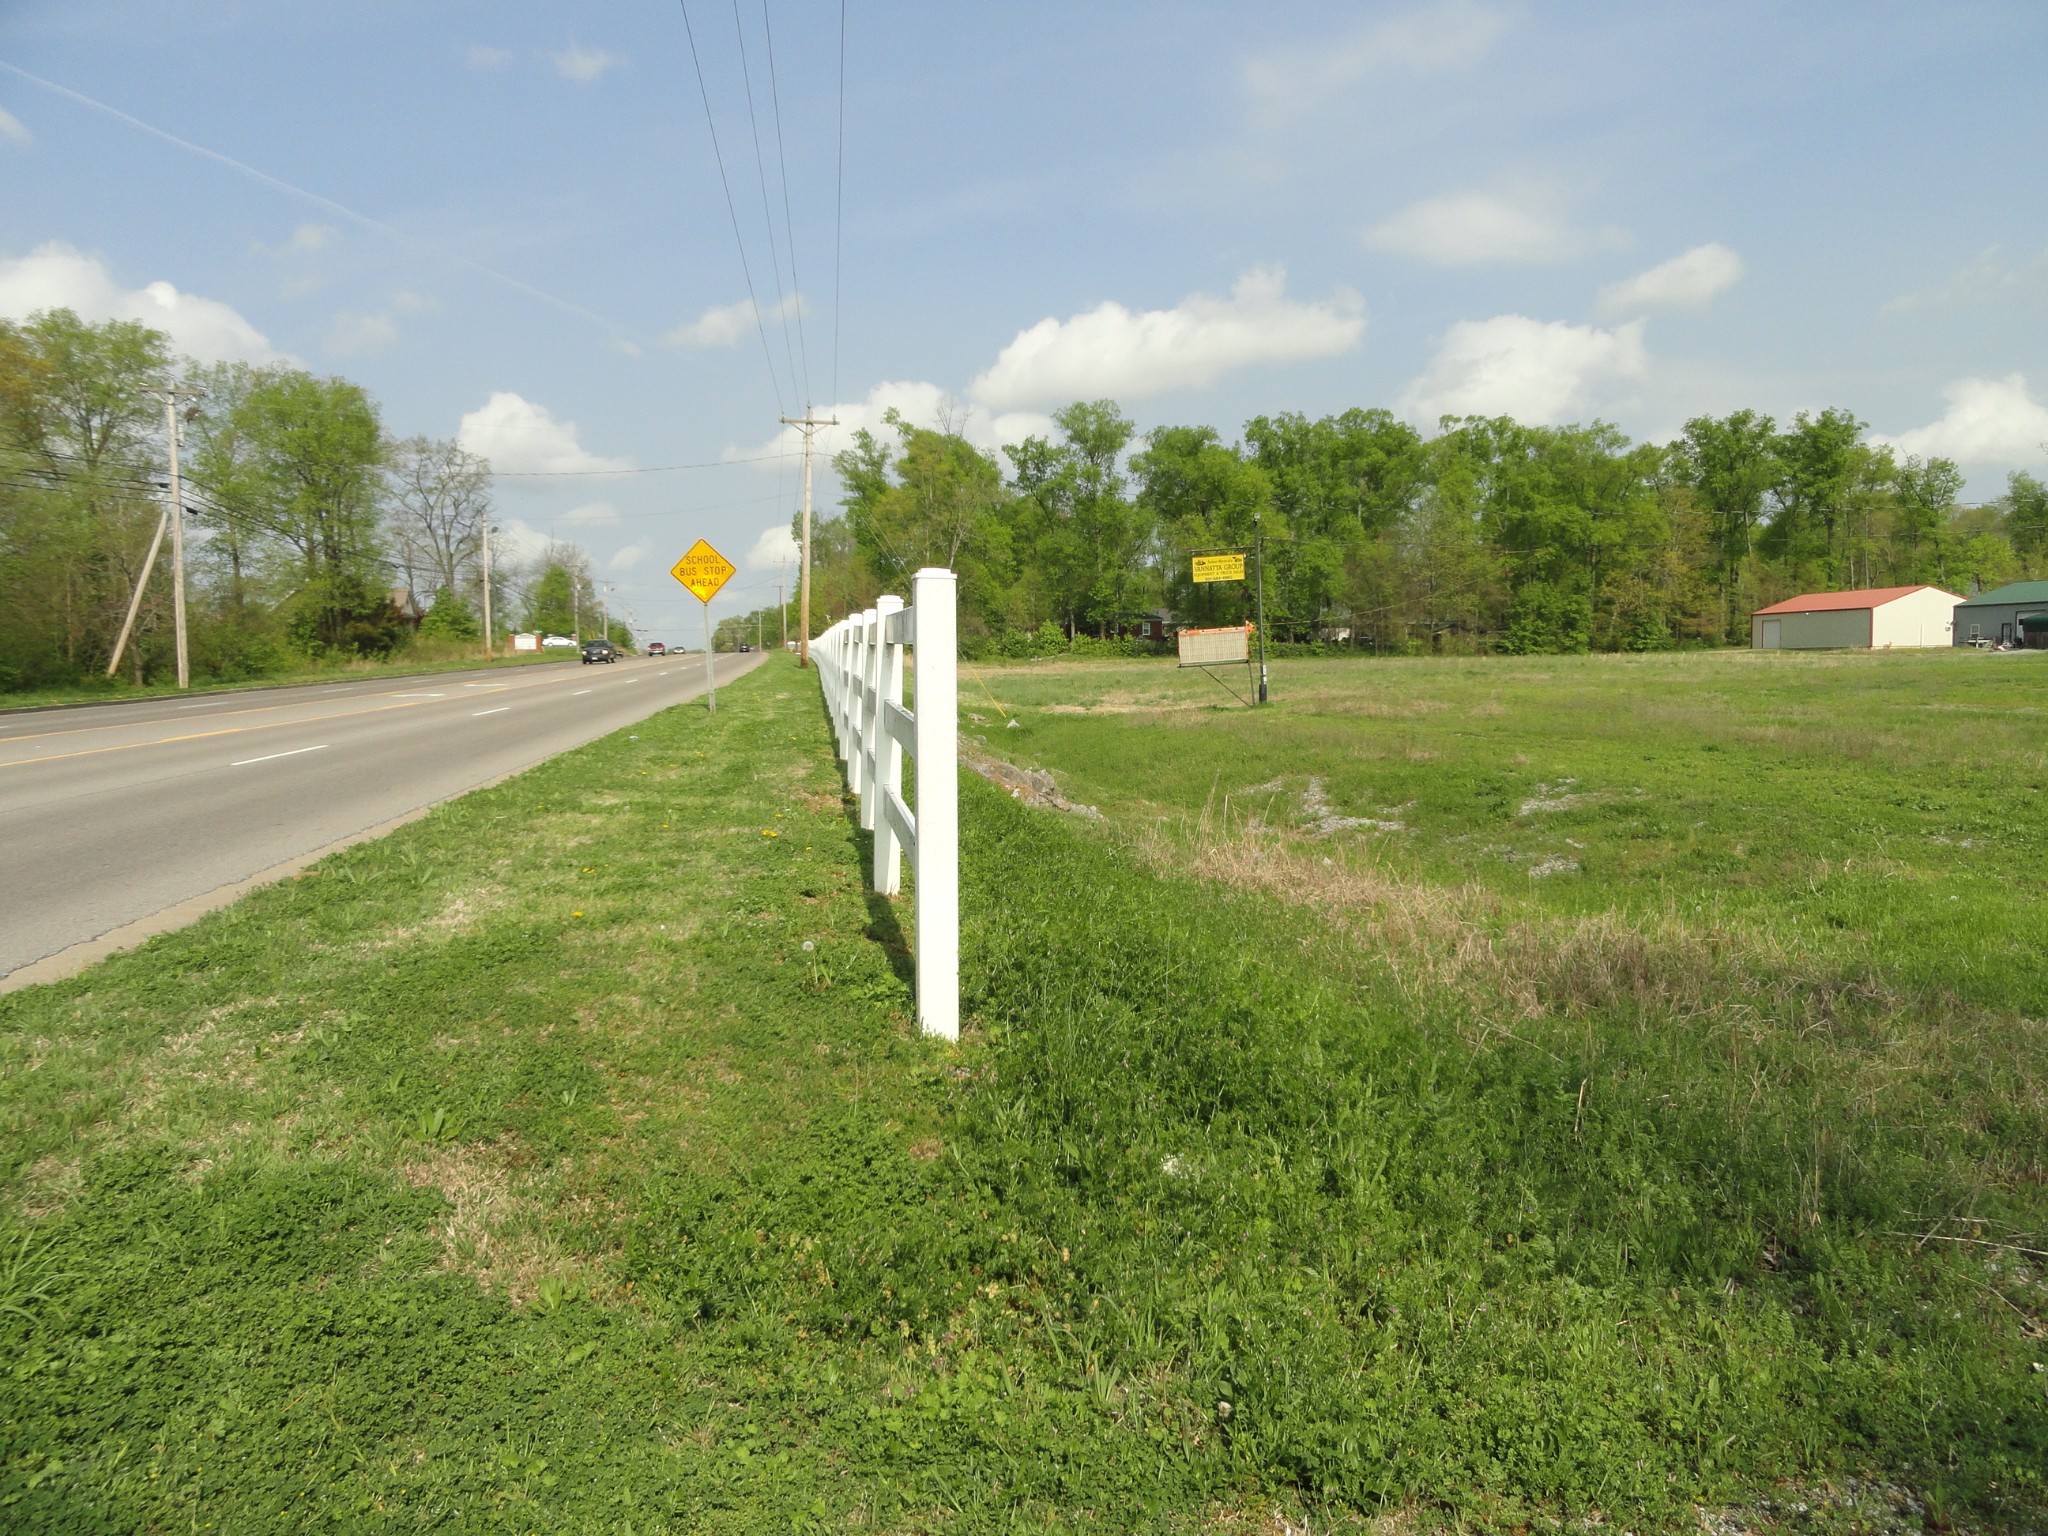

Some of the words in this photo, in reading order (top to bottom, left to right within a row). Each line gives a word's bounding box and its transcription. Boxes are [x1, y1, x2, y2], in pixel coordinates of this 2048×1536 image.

[685, 555, 720, 565] SCHOOL
[680, 567, 697, 576] BUS
[704, 566, 727, 575] STOP
[690, 578, 719, 587] AHEAD
